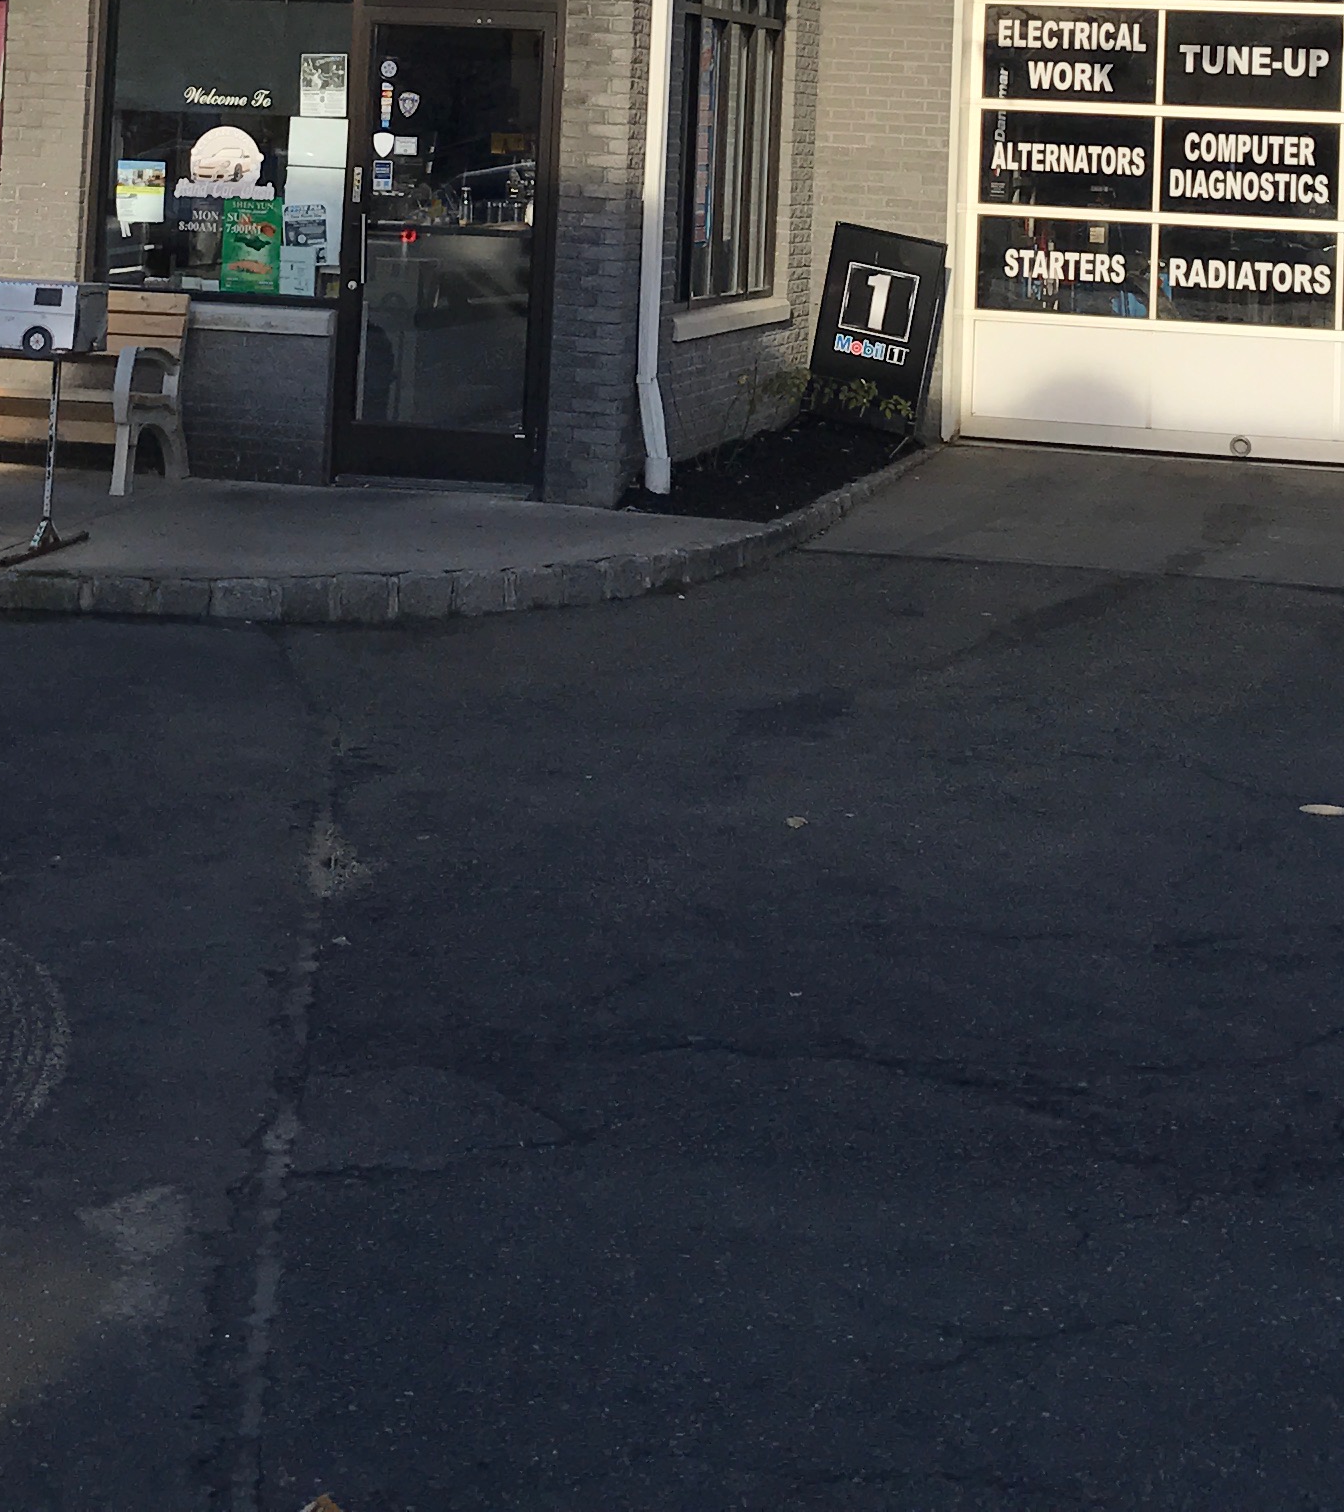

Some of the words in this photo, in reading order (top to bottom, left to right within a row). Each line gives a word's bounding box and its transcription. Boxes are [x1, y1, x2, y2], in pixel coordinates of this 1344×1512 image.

[998, 18, 1147, 52] ELECTRICAL
[1028, 61, 1113, 92] WORK
[1179, 45, 1329, 77] TUNE-UP
[183, 86, 248, 107] Welcome
[251, 89, 272, 108] To
[991, 141, 1145, 177] ALTERNATORS
[1184, 132, 1315, 166] COMPUTER
[1169, 168, 1329, 203] DIAGNOSTICS
[178, 221, 217, 233] 8:00AM
[192, 210, 219, 221] MON
[227, 211, 251, 223] SUN
[1004, 248, 1126, 283] STARTERS
[1168, 258, 1331, 294] RADIATORS
[867, 273, 892, 331] 1
[833, 333, 886, 361] Mobil
